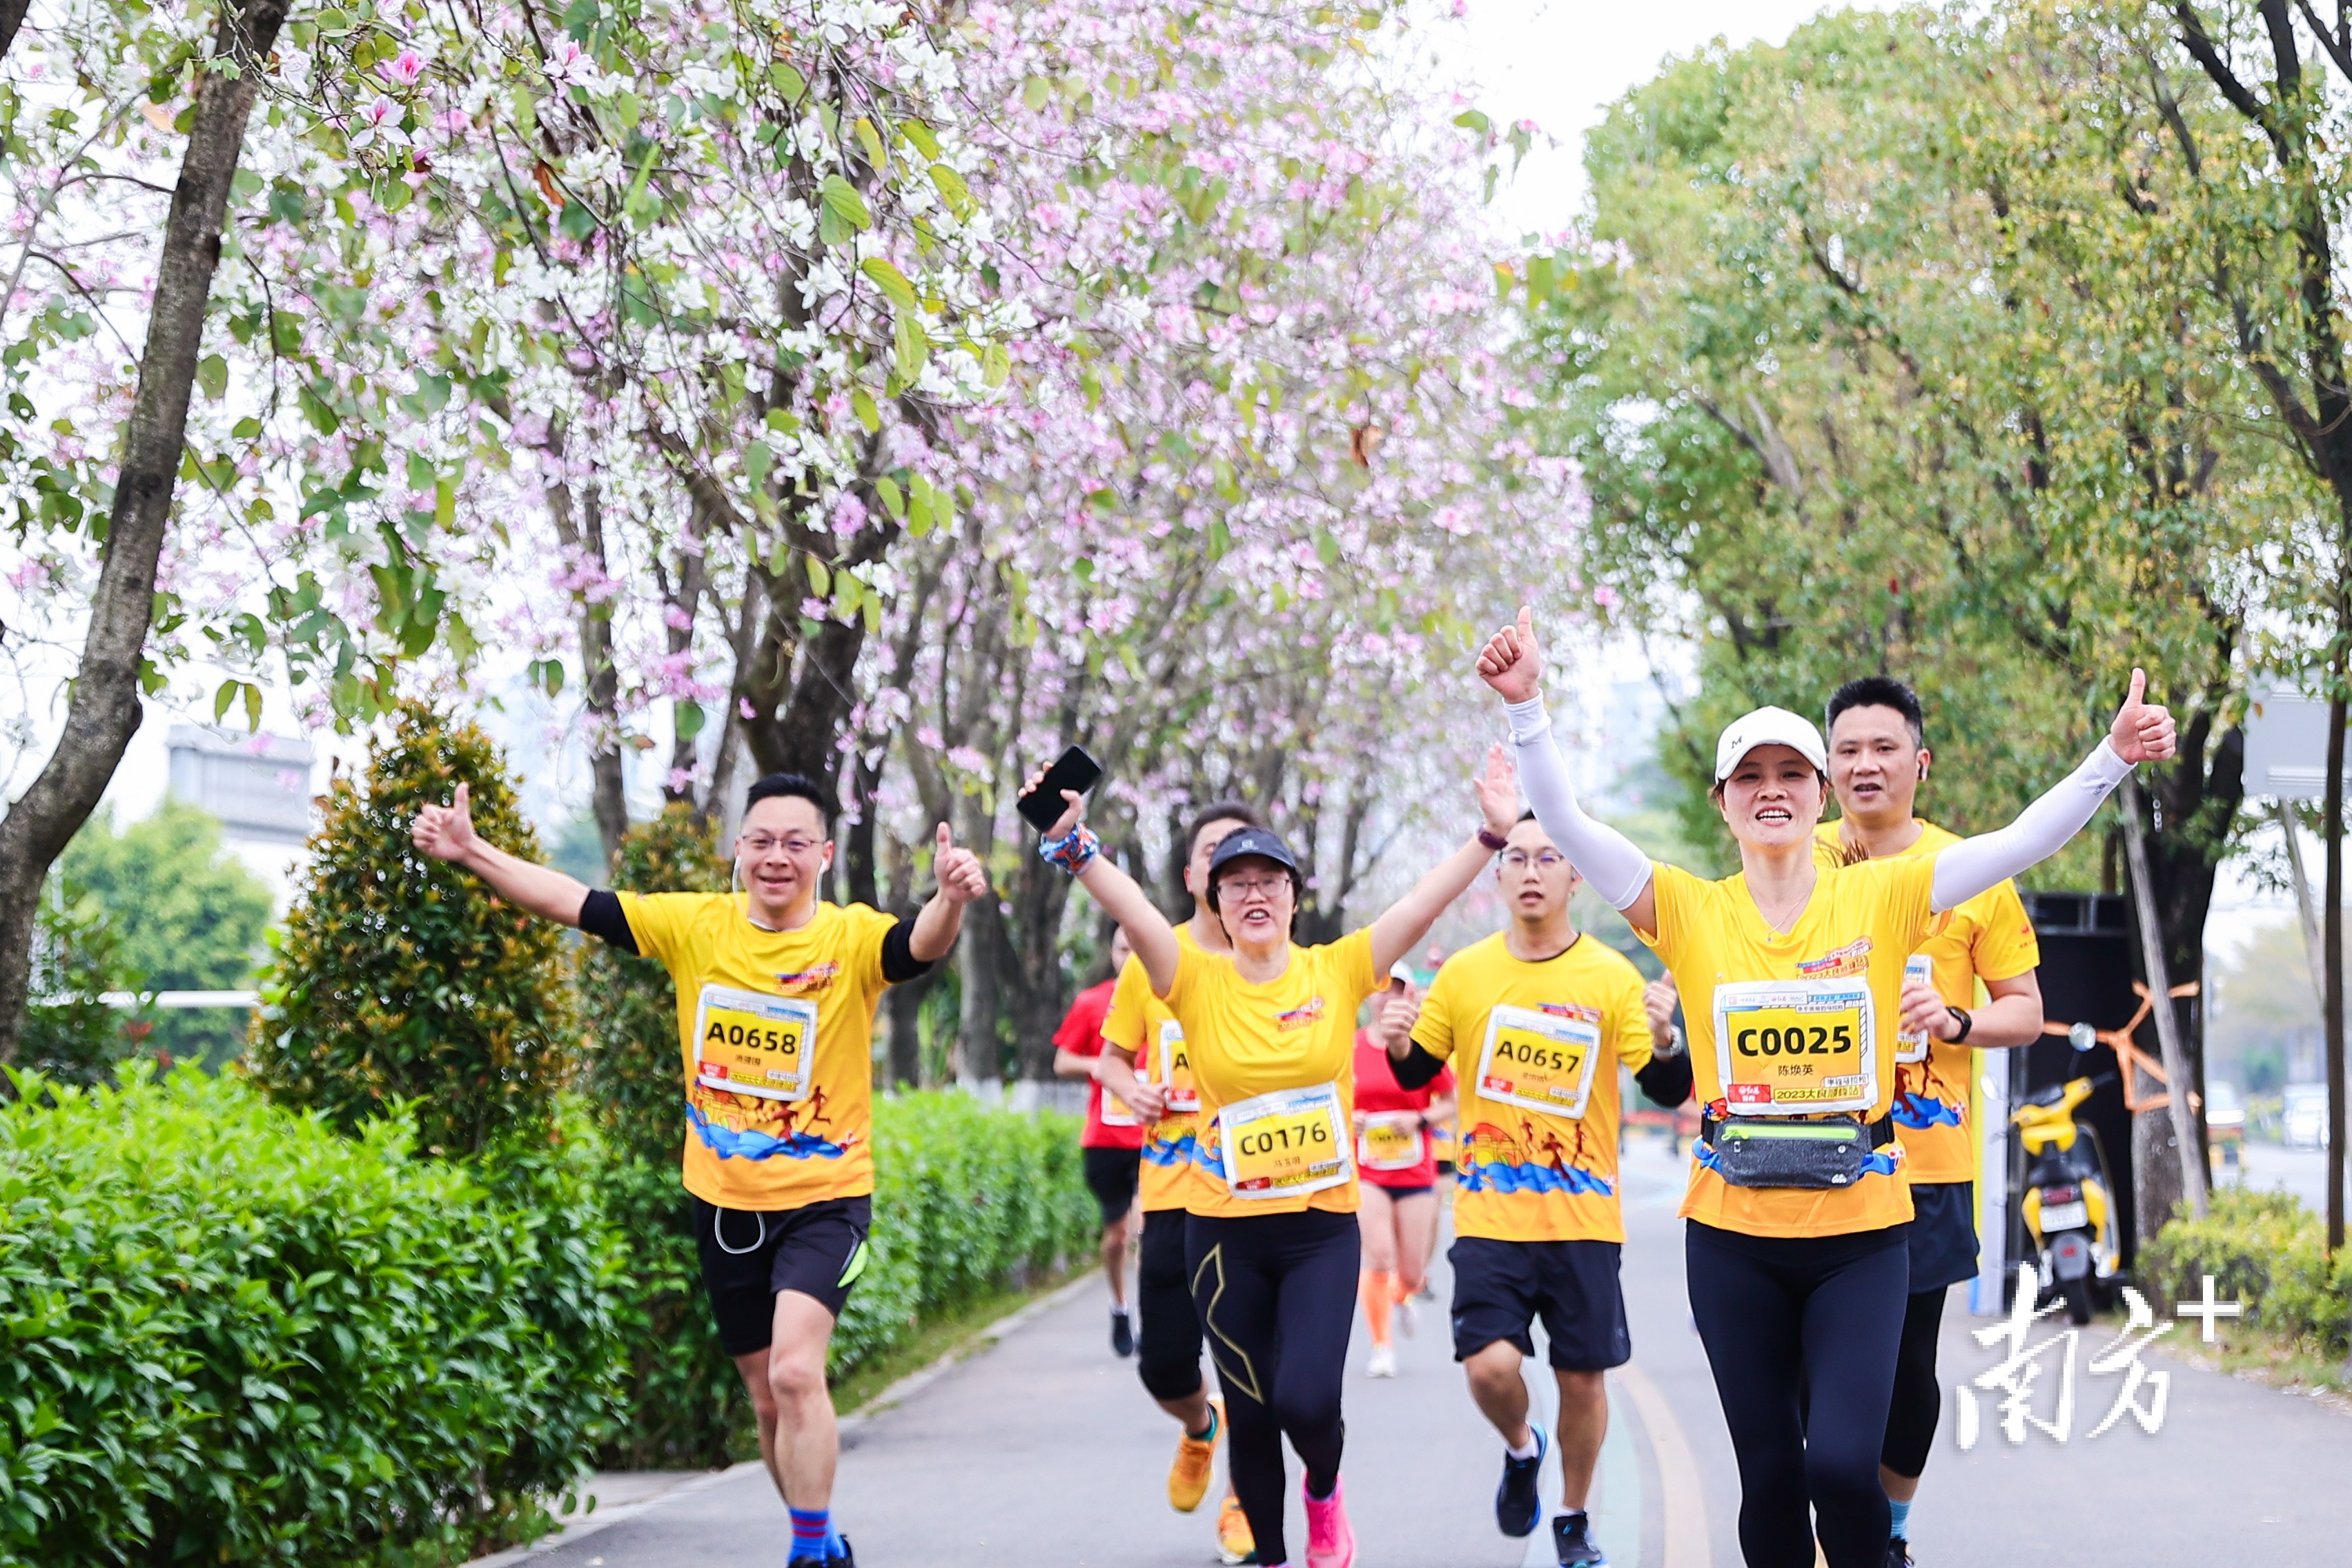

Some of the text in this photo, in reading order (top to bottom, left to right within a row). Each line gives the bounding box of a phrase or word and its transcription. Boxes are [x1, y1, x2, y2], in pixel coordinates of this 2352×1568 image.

[707, 1022, 796, 1055] A0658
[1737, 1026, 1852, 1056] C0025
[1496, 1041, 1579, 1073] A0657
[1241, 1121, 1326, 1156] C0176
